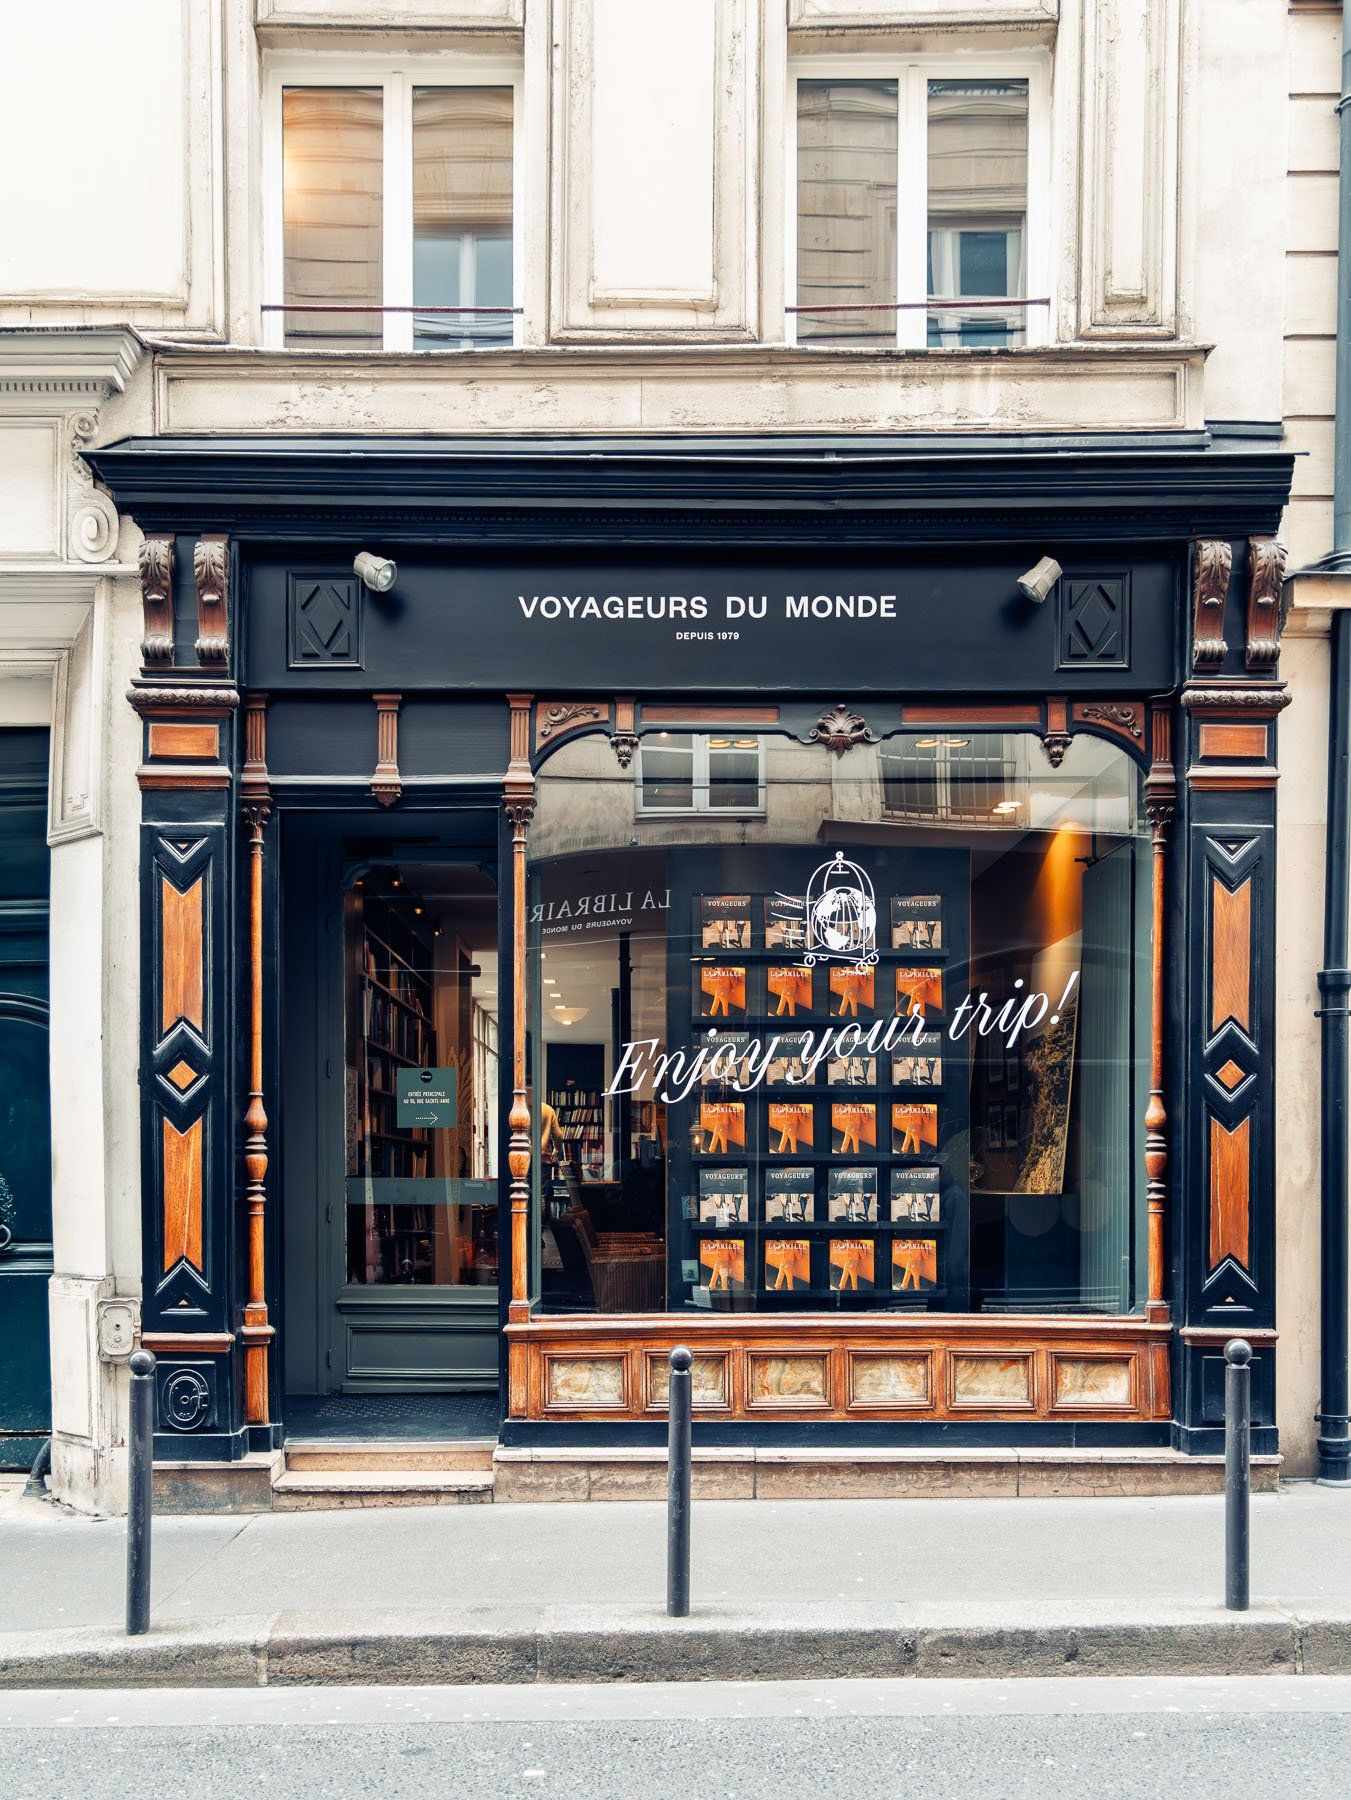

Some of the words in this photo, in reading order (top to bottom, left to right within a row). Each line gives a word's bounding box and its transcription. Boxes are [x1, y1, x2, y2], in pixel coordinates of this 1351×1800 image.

[518, 596, 708, 619] VOYAGEURS
[726, 596, 767, 618] DU
[785, 595, 897, 618] MONDE
[675, 632, 714, 640] DEPUIS
[716, 632, 740, 640] 1979
[600, 1028, 781, 1104] Enjoy
[786, 1003, 928, 1083] your
[948, 970, 1080, 1048] trip!
